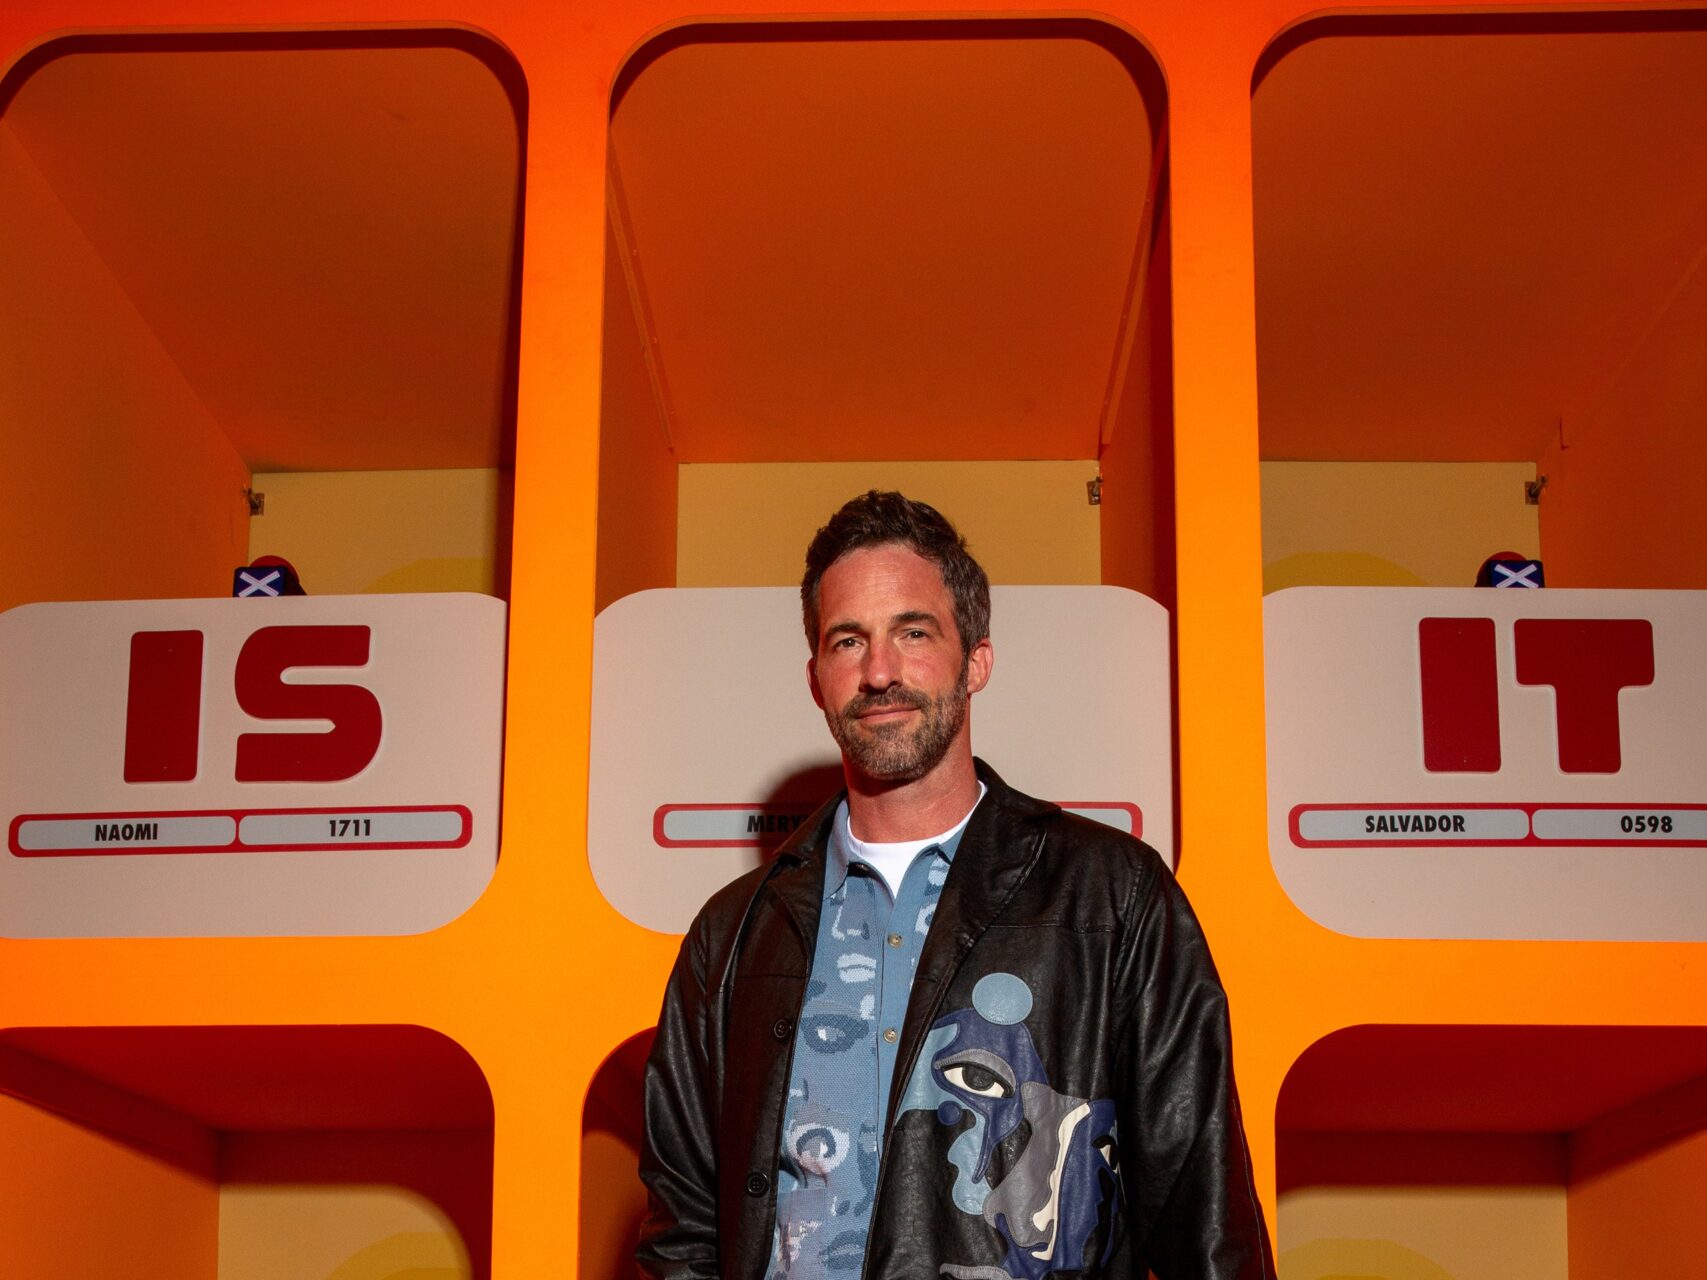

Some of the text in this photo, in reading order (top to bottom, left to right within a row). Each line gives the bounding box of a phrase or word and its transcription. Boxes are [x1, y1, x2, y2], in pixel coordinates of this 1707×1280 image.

[124, 625, 383, 784] IS
[1418, 617, 1655, 774] IT
[94, 819, 372, 842] NAOMI 1711
[747, 815, 808, 833] MERY
[1365, 815, 1673, 834] SALVADOR 0598
